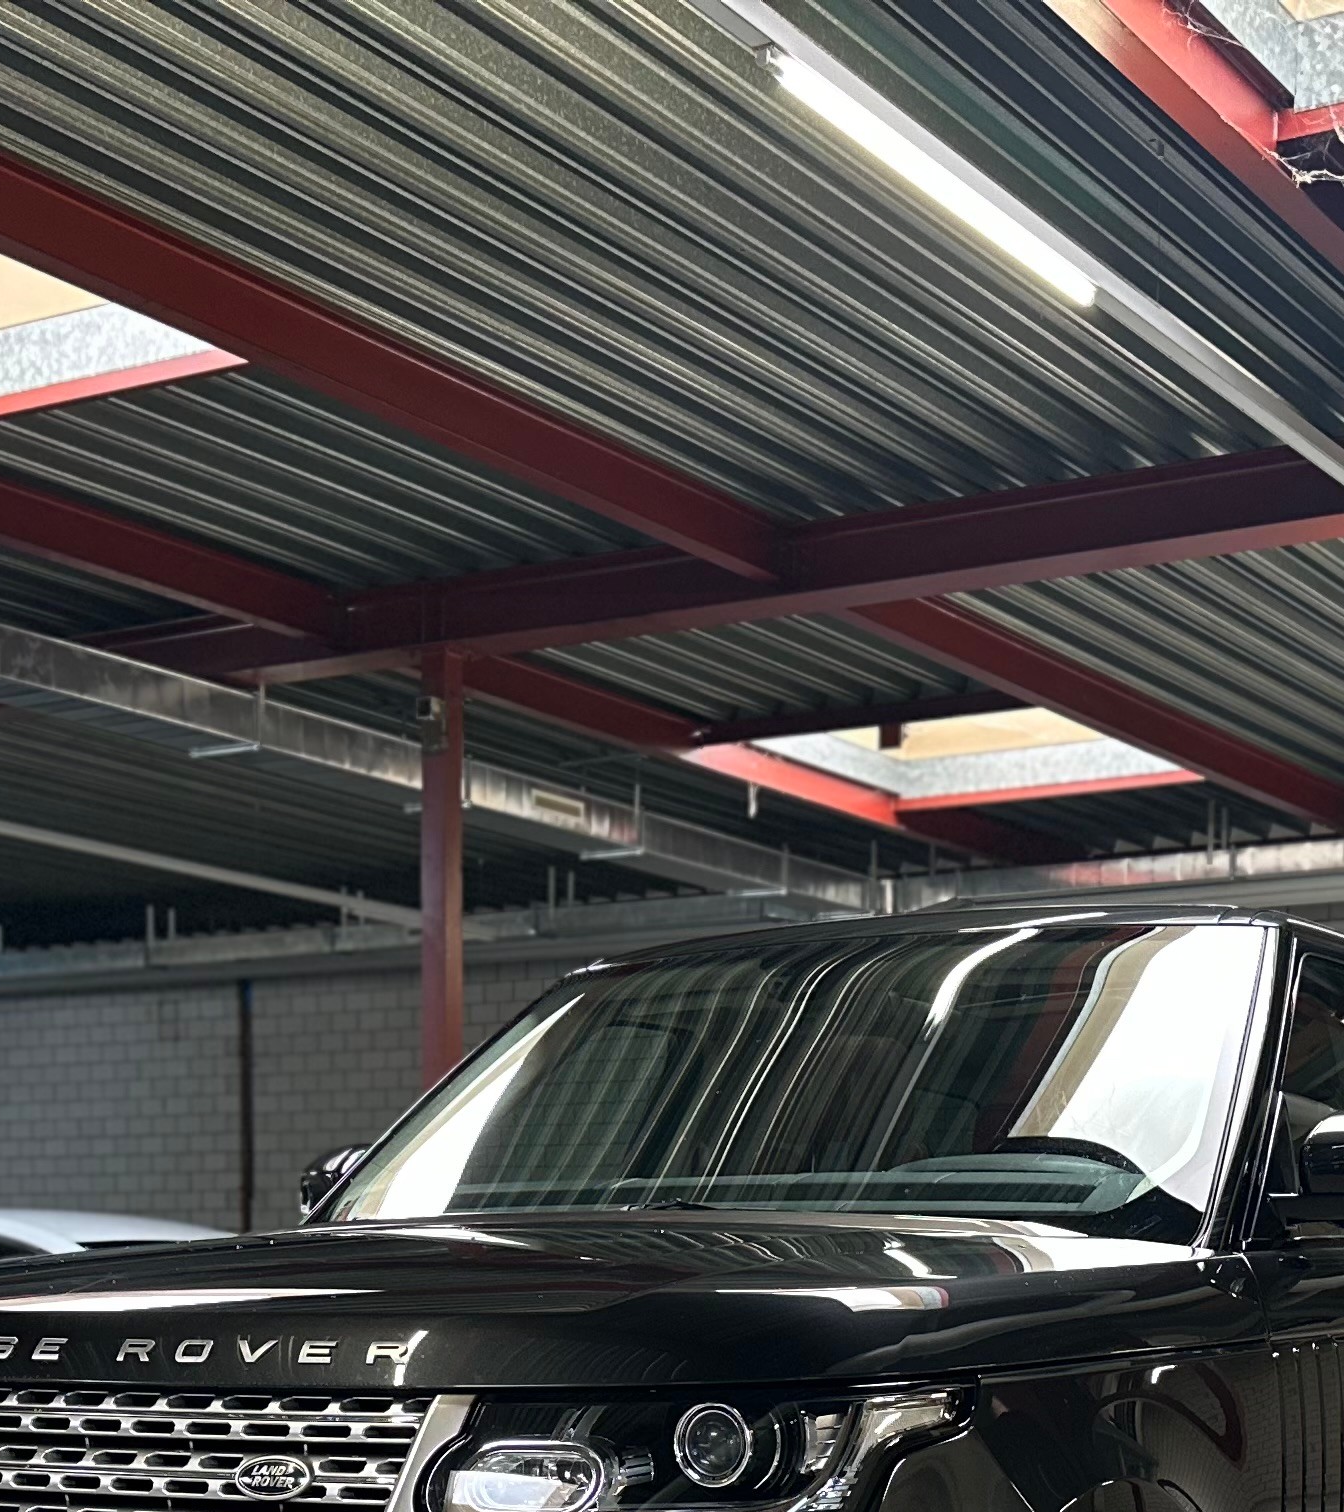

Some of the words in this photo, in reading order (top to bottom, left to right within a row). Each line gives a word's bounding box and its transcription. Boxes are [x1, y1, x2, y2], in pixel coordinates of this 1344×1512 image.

[115, 1337, 409, 1366] ROVER
[251, 1464, 287, 1476] LAND
[251, 1475, 295, 1489] ROVER
